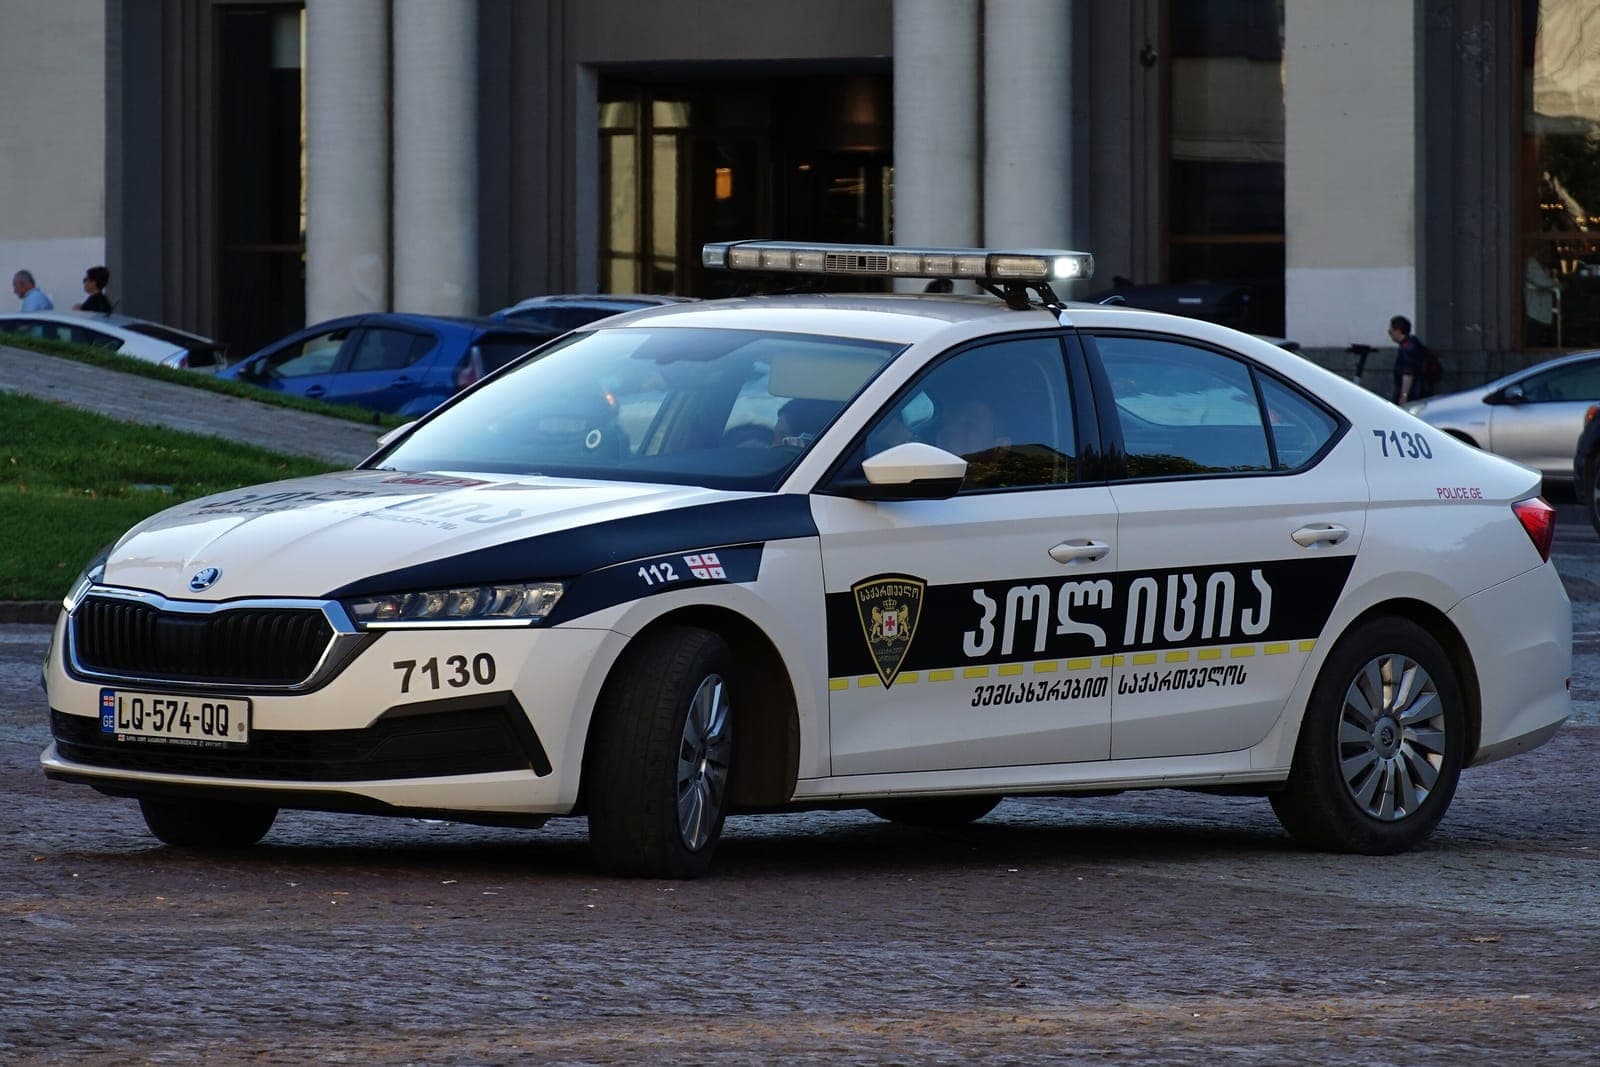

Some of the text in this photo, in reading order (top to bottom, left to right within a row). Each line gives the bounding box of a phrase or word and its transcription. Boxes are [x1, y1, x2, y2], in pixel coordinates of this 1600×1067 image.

[1373, 430, 1432, 459] 7130
[1437, 487, 1482, 500] POLICE.GE
[638, 562, 680, 586] 112
[860, 584, 919, 602] საქართველო
[962, 568, 1273, 658] პოლიცია
[393, 652, 496, 694] 7130
[971, 664, 1247, 707] ვემსახურებით საქართველოს
[103, 715, 114, 728] GE
[118, 696, 229, 737] LQ-574-QQ
